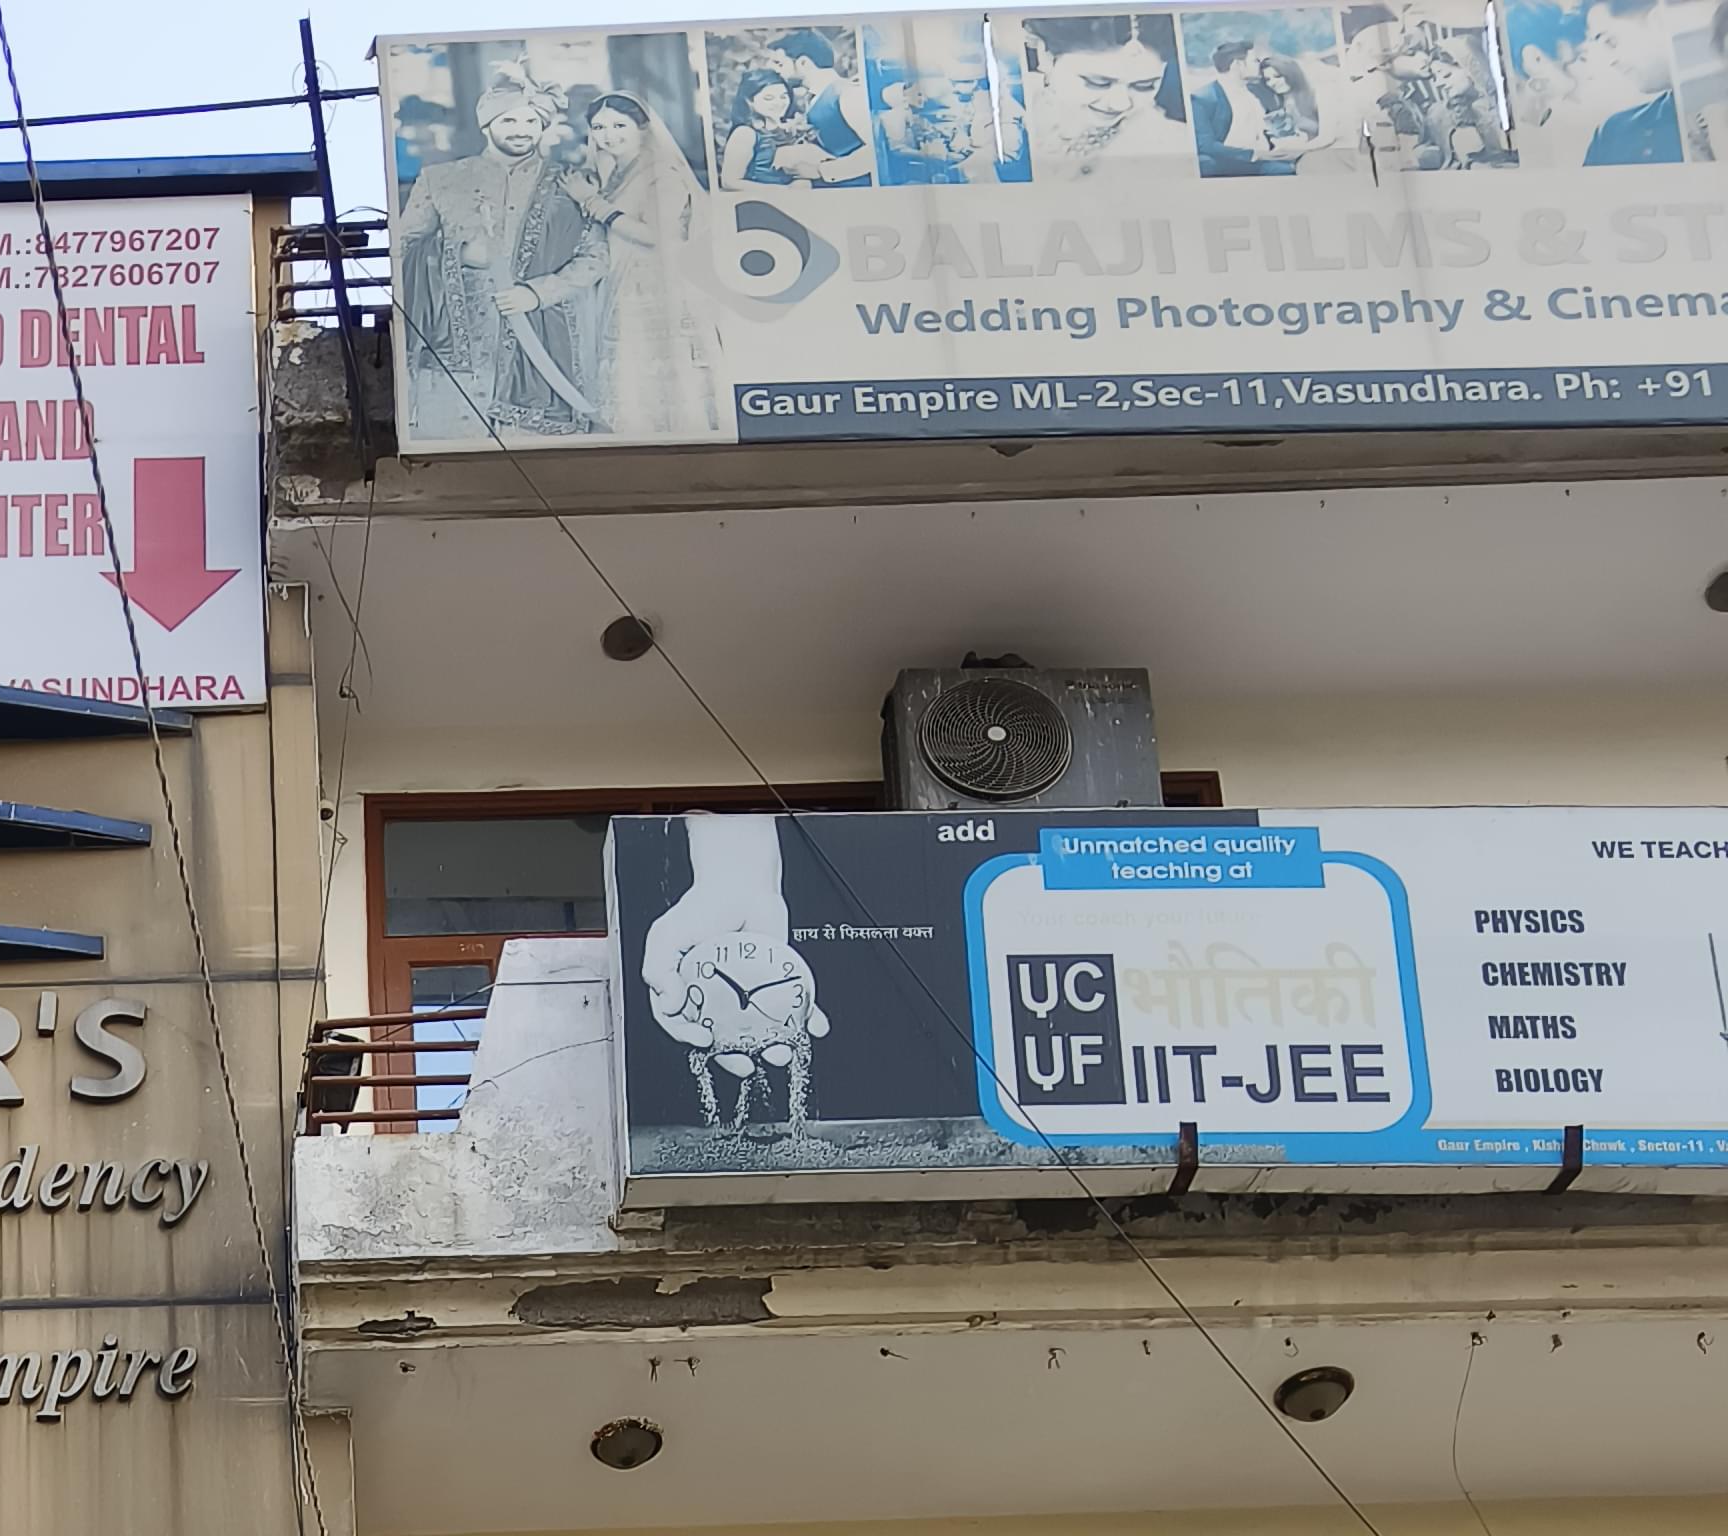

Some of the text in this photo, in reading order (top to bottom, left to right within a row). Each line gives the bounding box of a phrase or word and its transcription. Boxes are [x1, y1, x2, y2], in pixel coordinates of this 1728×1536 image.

[845, 207, 1591, 282] BALAJI FILMS &
[856, 289, 1532, 339] Wedding Photography &
[20, 305, 206, 367] DENTAL
[740, 369, 1712, 419] Gaur Empire Ph: +91
[936, 819, 996, 844] add
[1061, 832, 1296, 857] Unmatched quality
[1110, 859, 1253, 884] teaching at
[823, 924, 836, 939] से
[1474, 909, 1584, 934] PHYSICS
[1482, 962, 1627, 987] CHEMISTRY
[1488, 1015, 1577, 1040] MATHS
[1131, 1044, 1391, 1106] IIT-JEE
[1496, 1068, 1603, 1093] BIOLOGY
